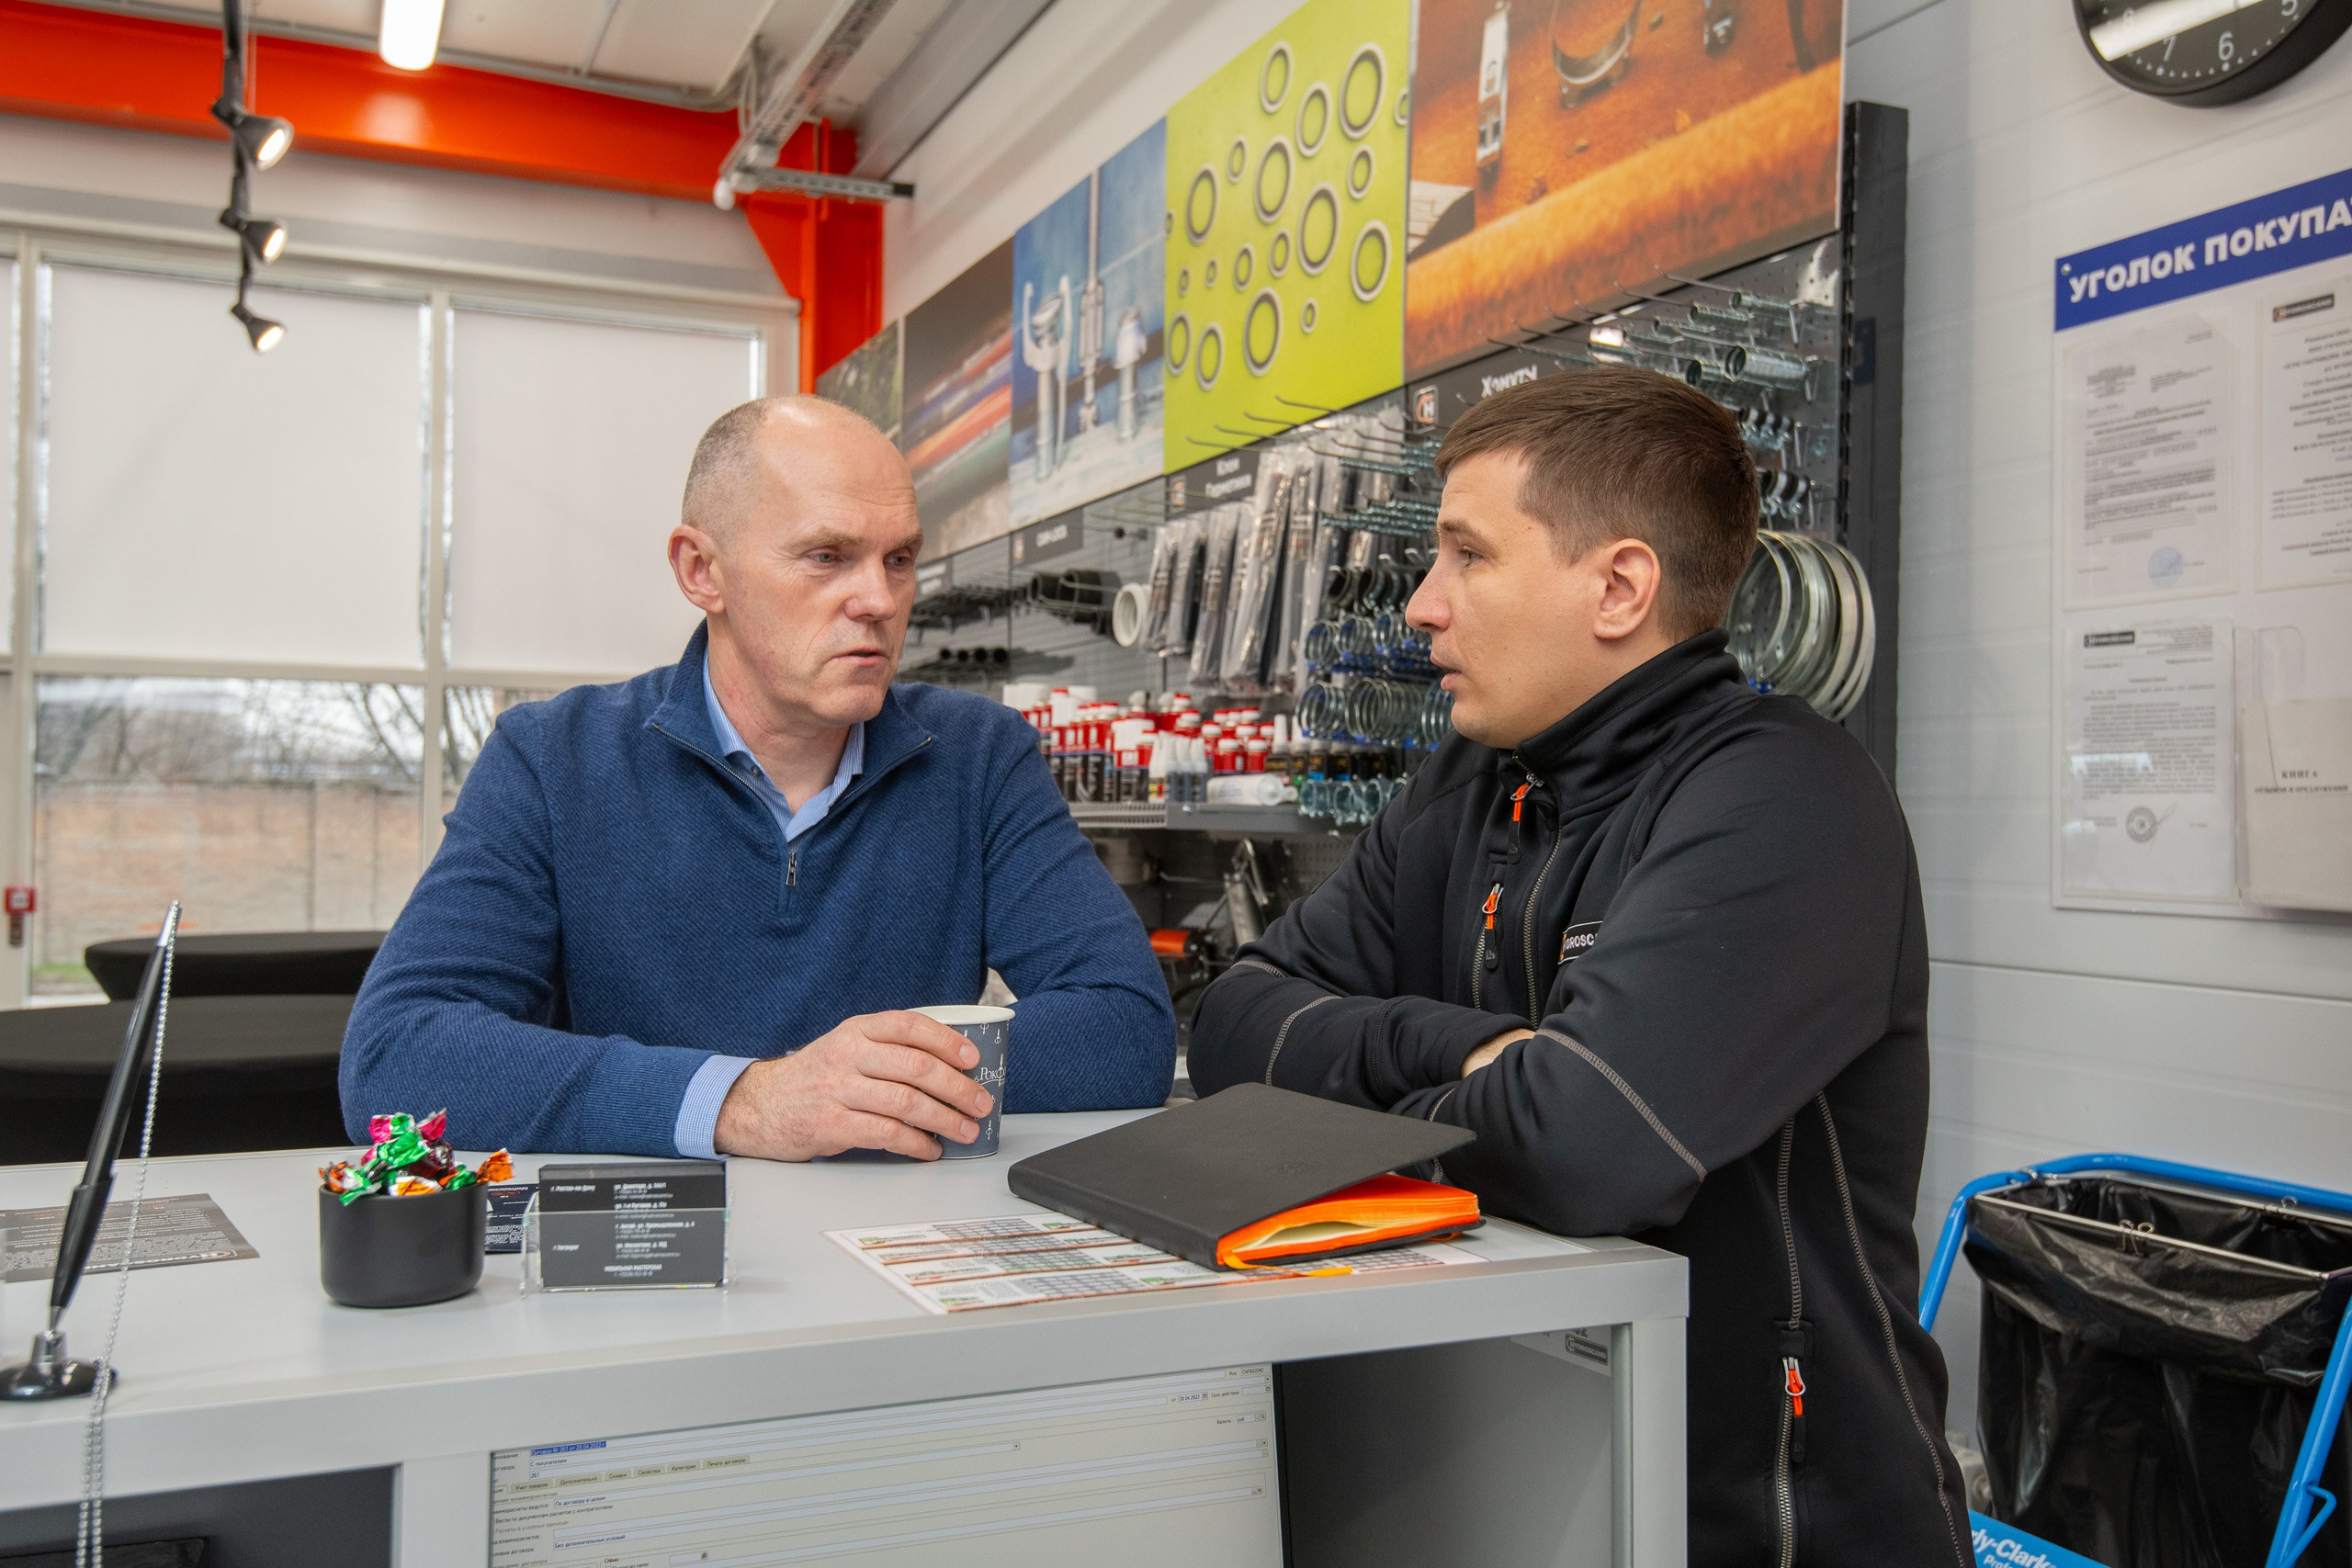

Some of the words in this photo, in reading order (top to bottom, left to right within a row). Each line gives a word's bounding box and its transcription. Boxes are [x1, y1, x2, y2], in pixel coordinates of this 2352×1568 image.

[2163, 35, 2177, 62] 7
[2218, 30, 2234, 62] 6
[2068, 242, 2196, 303] УГОЛОК
[2204, 197, 2352, 266] ПОКУПА
[2281, 770, 2317, 779] КНИГА
